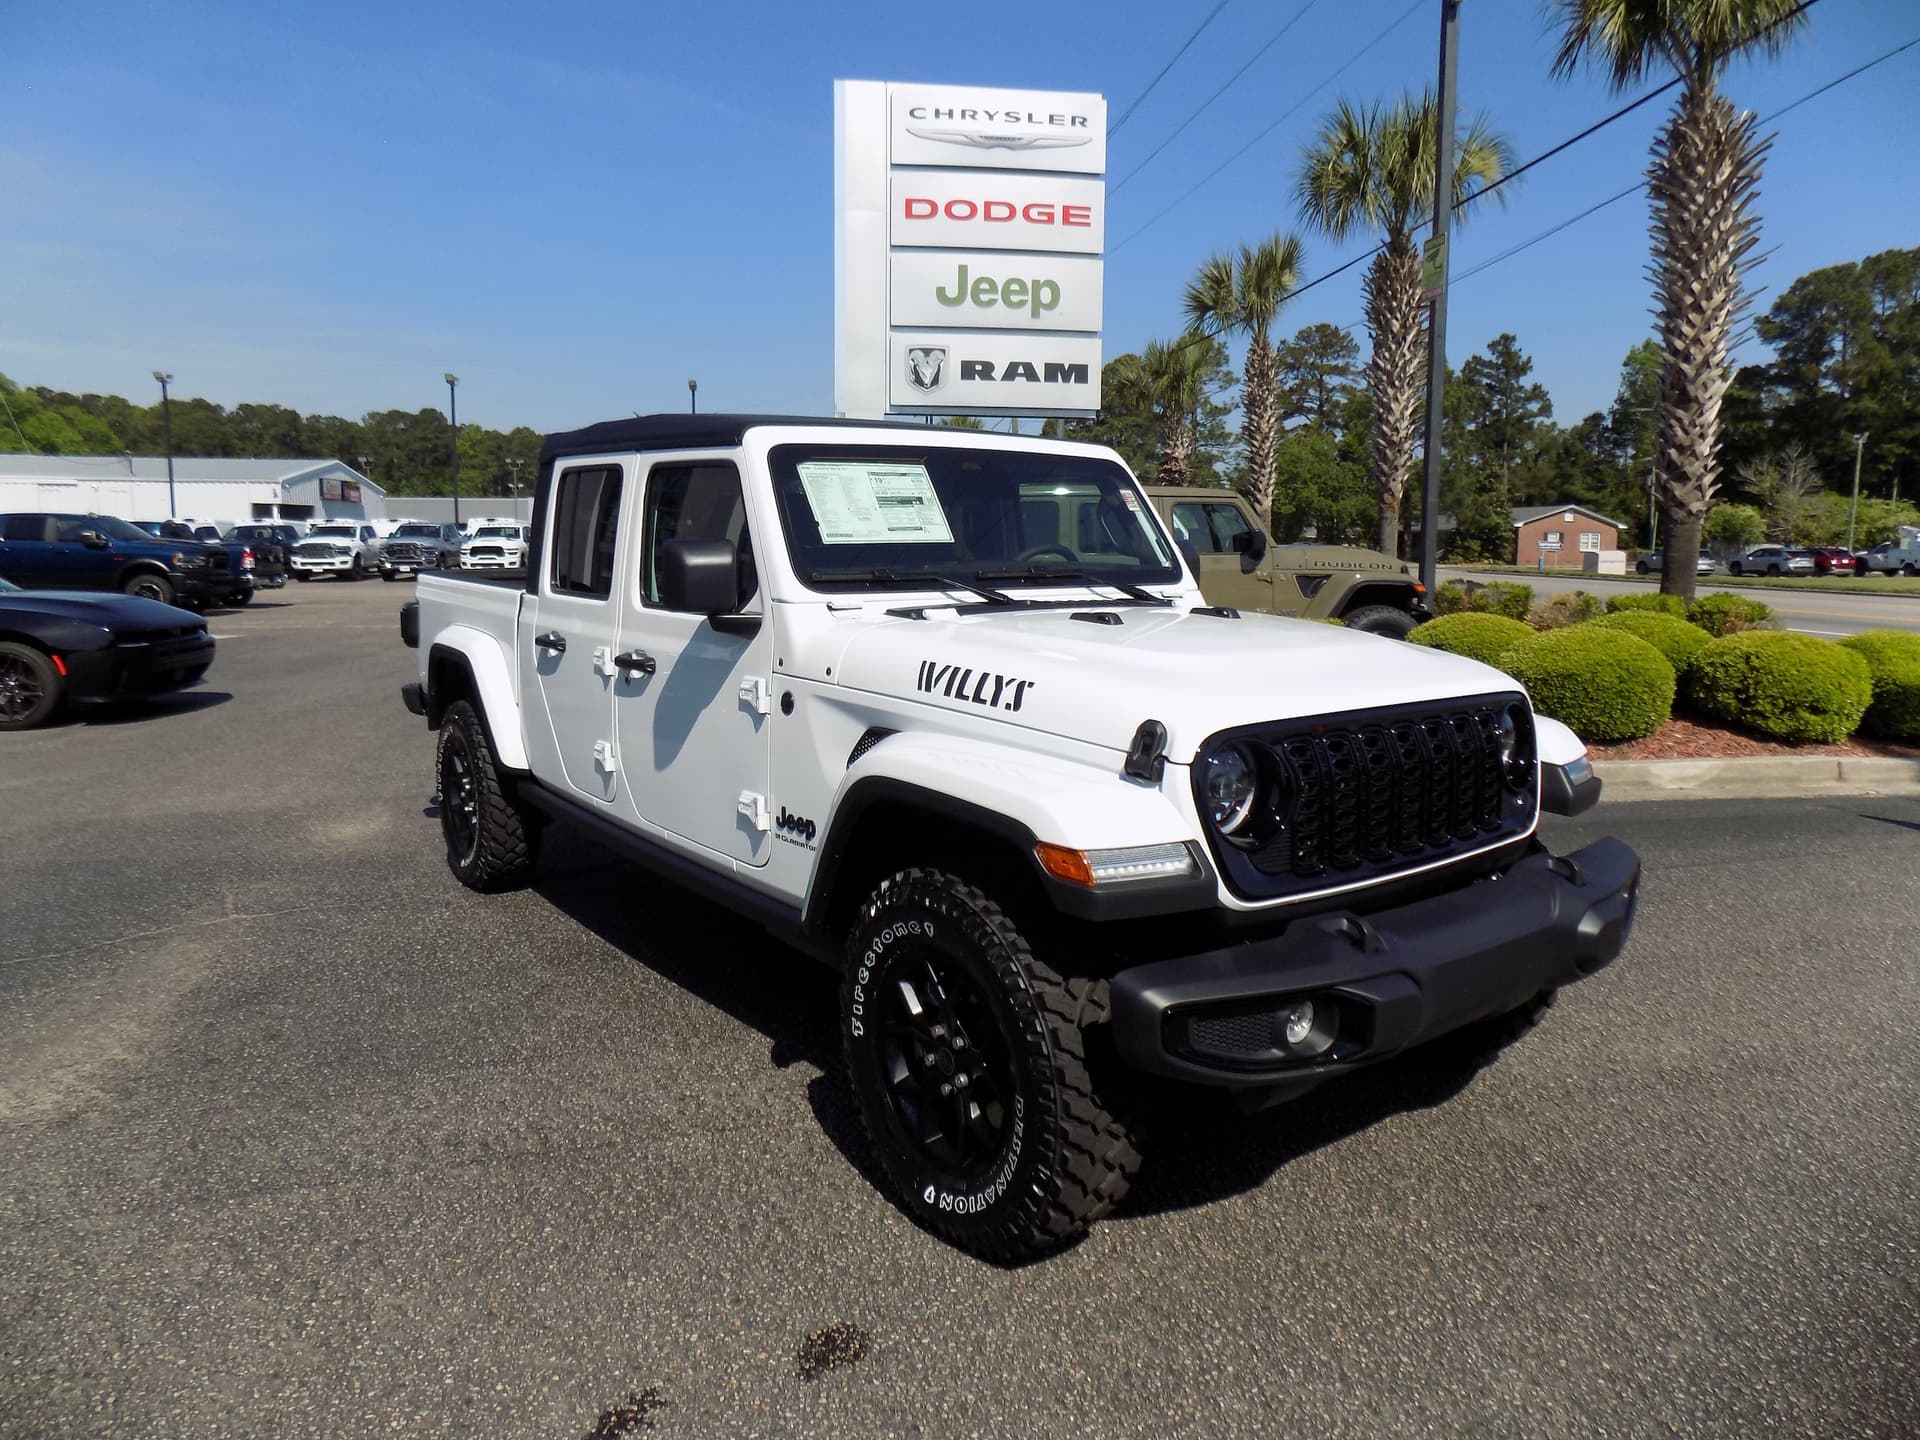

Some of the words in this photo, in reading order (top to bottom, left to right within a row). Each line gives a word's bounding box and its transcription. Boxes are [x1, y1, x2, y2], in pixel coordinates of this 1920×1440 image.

[909, 107, 1088, 128] CHRYSLER
[905, 198, 1091, 227] DODGE
[935, 264, 1061, 319] Jeep
[960, 360, 1088, 384] RAM
[1314, 561, 1392, 569] RUBICON
[917, 660, 1035, 712] WILLYS
[775, 806, 817, 842] Jeep
[851, 921, 921, 1037] Firestone
[939, 1095, 1024, 1214] DESTINATION
